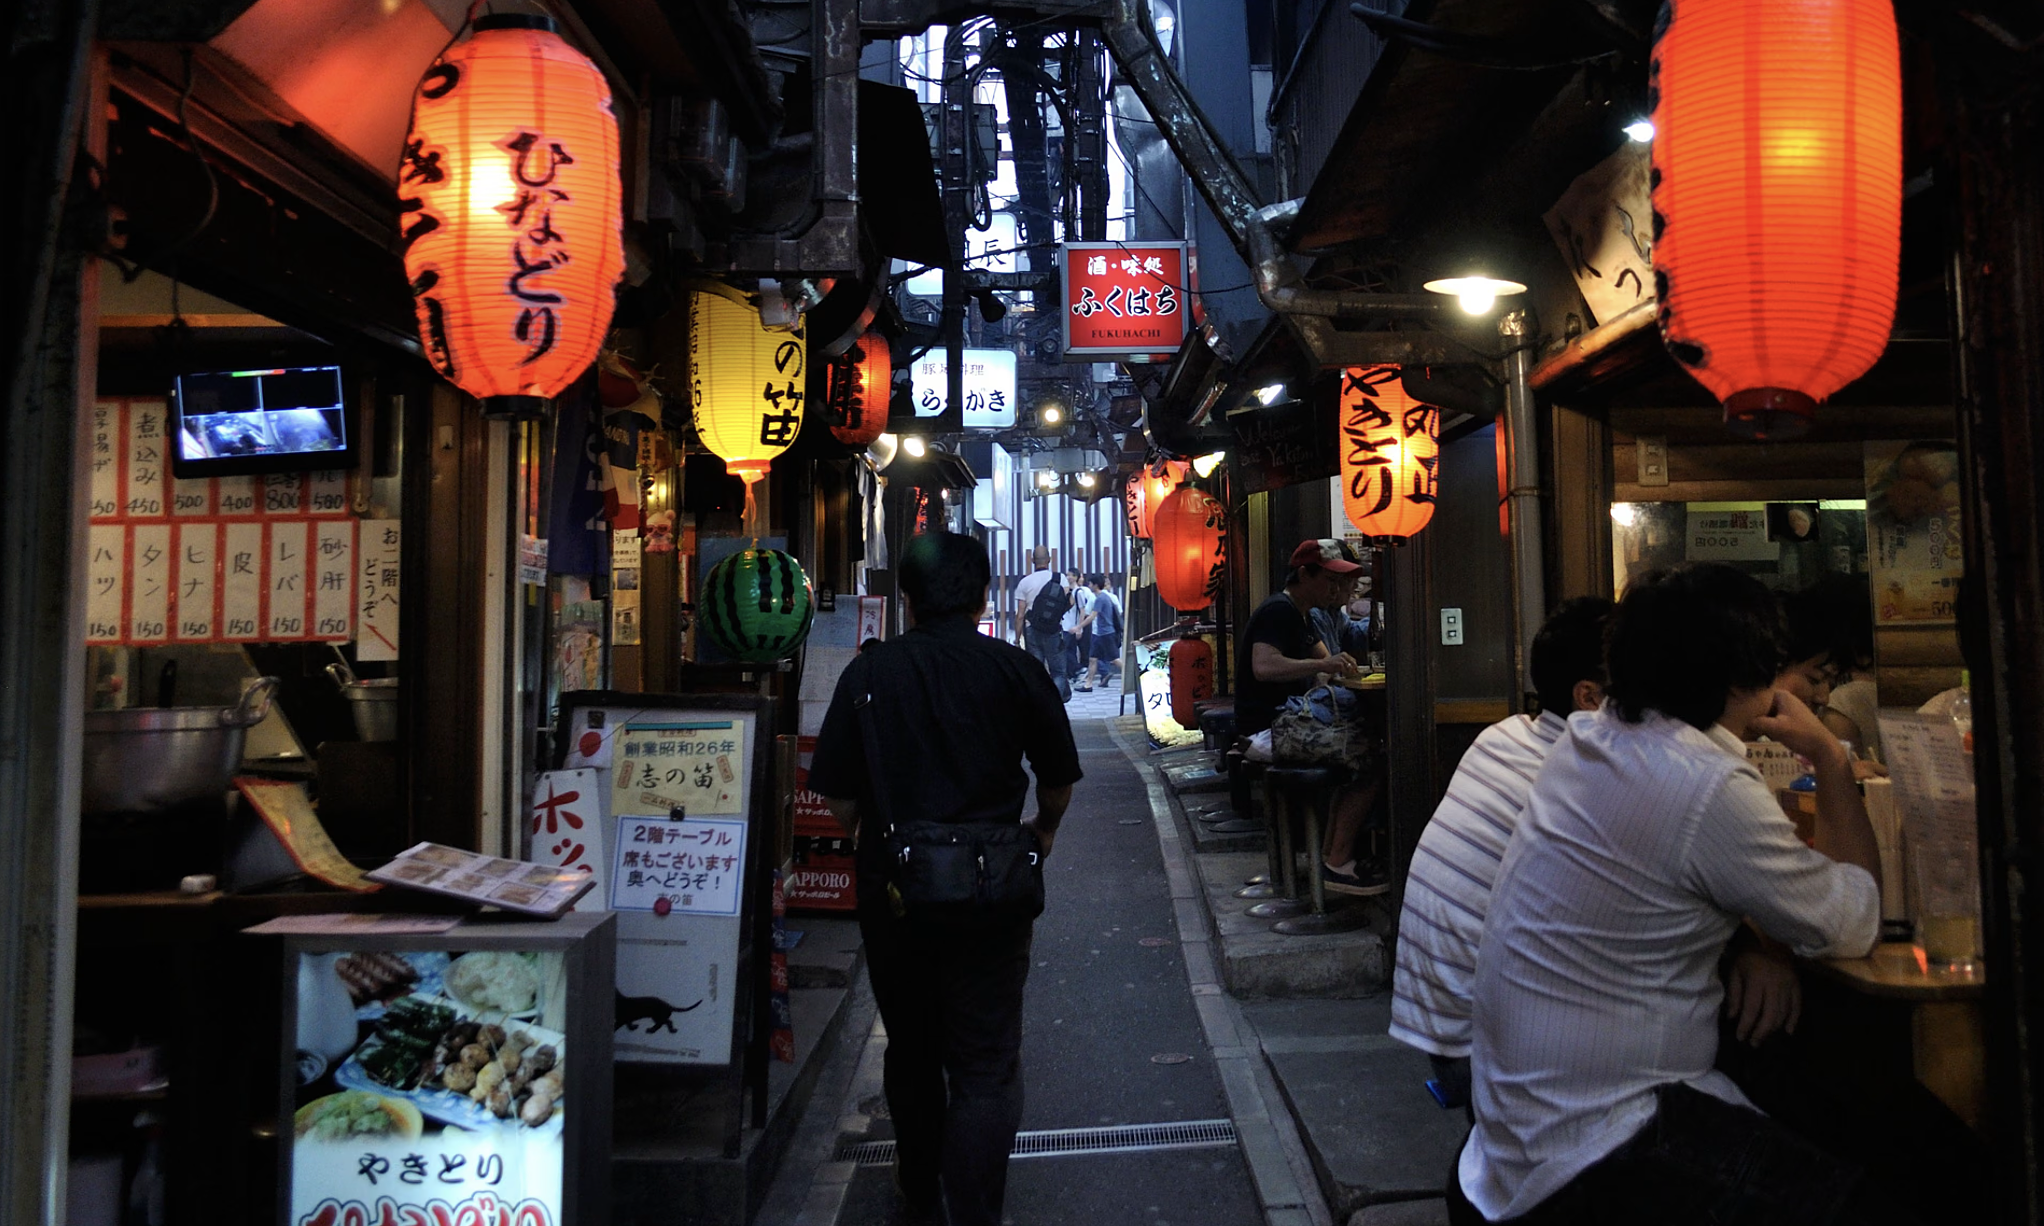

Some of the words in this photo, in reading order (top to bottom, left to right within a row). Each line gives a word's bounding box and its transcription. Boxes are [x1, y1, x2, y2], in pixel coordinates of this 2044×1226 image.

[499, 133, 575, 370] ひなどり
[1087, 255, 1164, 276] 酒・味処
[1072, 284, 1178, 317] ふくはち
[1091, 329, 1161, 338] FUKUHACHI
[761, 322, 803, 447] の笛
[921, 387, 1005, 412] らがき
[136, 412, 160, 484] 煮込み
[1343, 367, 1399, 519] やきとり
[124, 498, 159, 513] 450
[175, 495, 203, 510] 500
[221, 495, 252, 510] 400
[94, 547, 115, 595] ハツ
[142, 544, 162, 596] タン
[184, 545, 206, 598] ヒナ
[233, 551, 255, 575] 皮
[276, 542, 299, 591] レバ
[319, 537, 348, 590] 砂肝
[381, 527, 399, 605] お二階へ
[362, 558, 379, 618] どうぞ
[89, 622, 117, 636] 150
[137, 621, 163, 635] 150
[182, 622, 208, 635] 150
[228, 620, 255, 634] 150
[273, 617, 301, 633] 150
[319, 618, 347, 633] 150
[624, 740, 735, 757] 創業昭和26年
[636, 762, 714, 789] 志の笛
[533, 780, 593, 873] ホッ
[633, 825, 732, 846] 2階テーブル
[623, 850, 737, 872] 席もございます
[627, 870, 720, 890] 奥へどうぞ！
[794, 871, 850, 889] APPORO
[657, 893, 693, 906] の笛
[358, 1152, 504, 1186] やきとり
